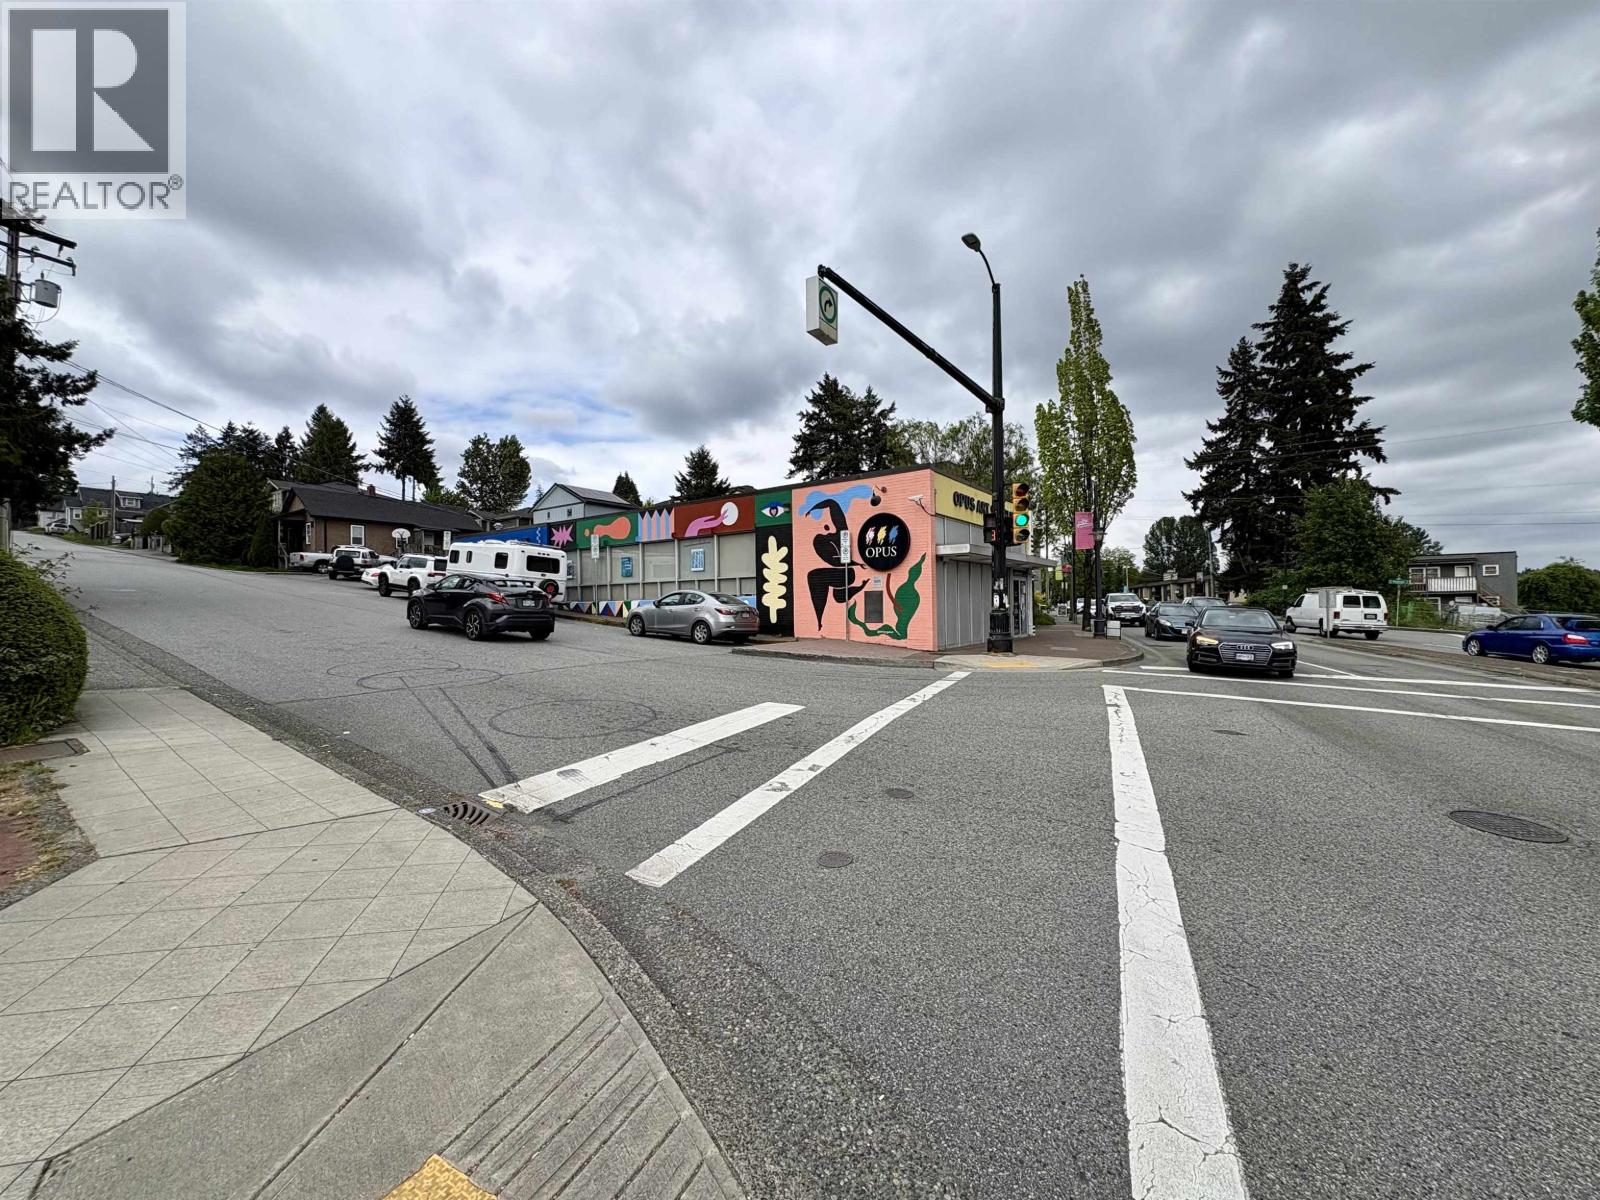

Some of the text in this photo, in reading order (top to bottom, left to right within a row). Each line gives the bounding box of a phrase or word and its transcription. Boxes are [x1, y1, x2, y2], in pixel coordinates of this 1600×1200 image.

[953, 491, 975, 512] OPUS
[976, 500, 990, 514] ART
[865, 546, 897, 558] OPUS
